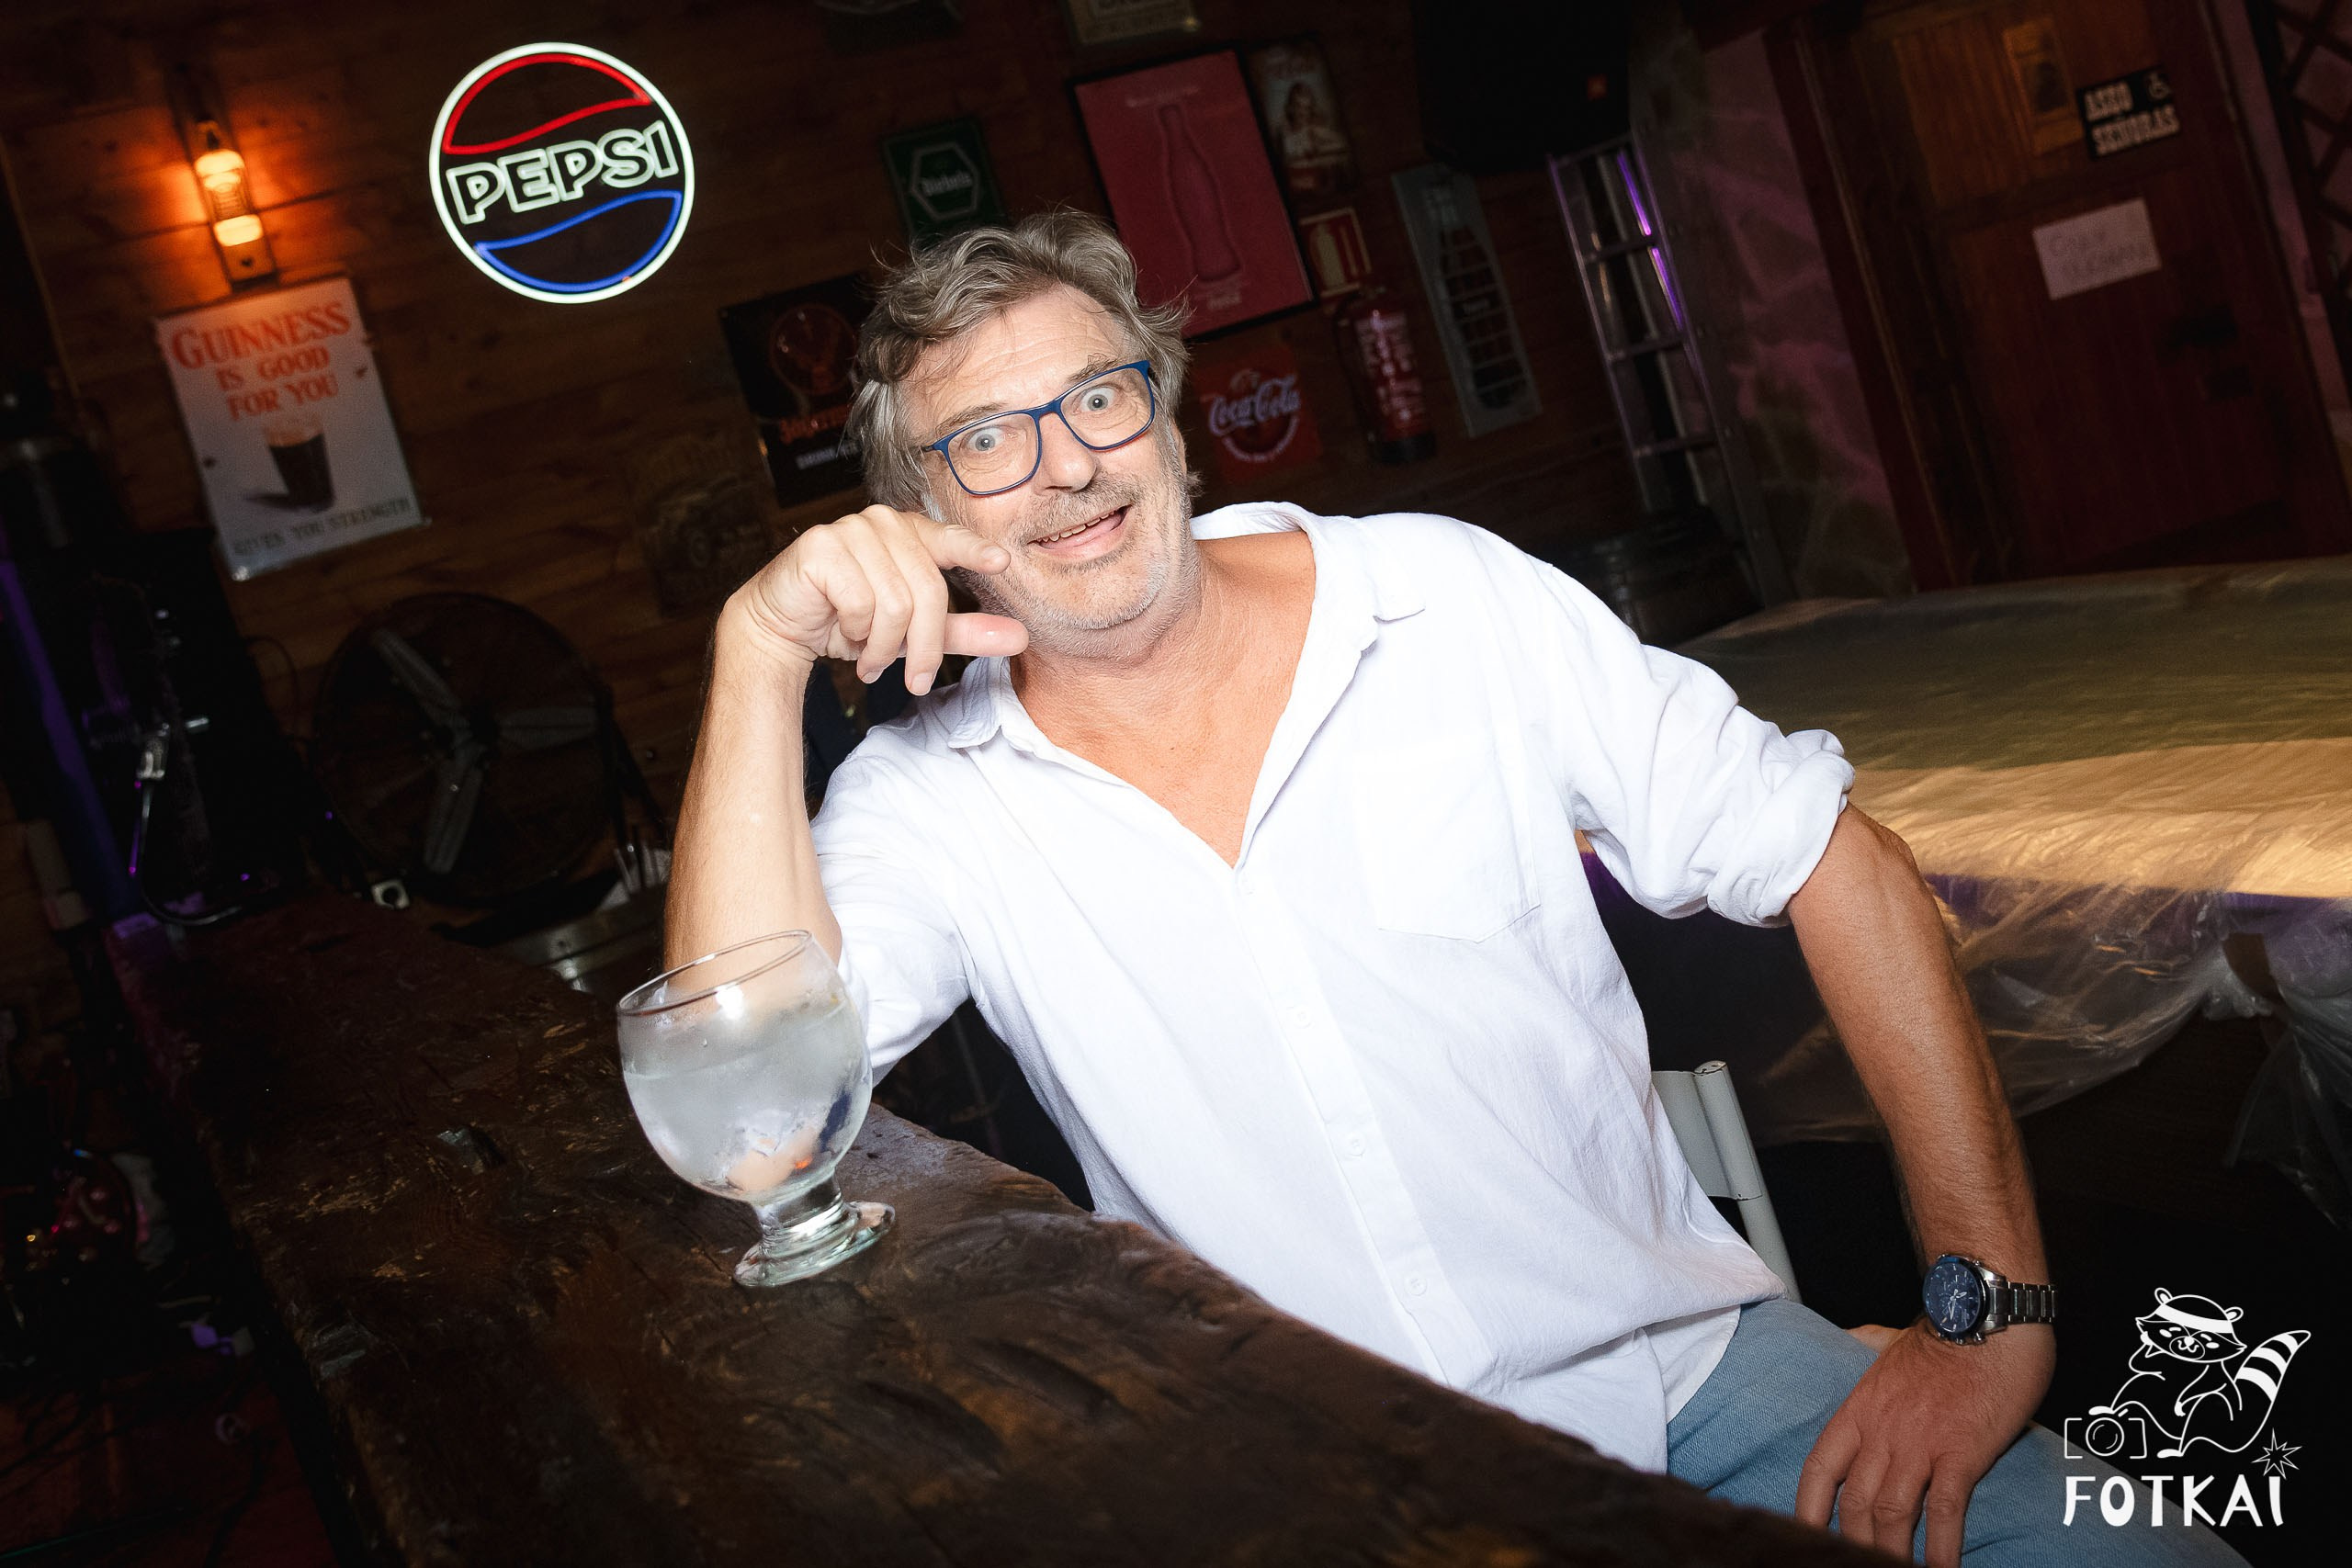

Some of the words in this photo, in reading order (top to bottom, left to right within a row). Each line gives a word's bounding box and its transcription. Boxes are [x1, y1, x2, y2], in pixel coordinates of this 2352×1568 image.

[446, 118, 680, 226] PEPSI
[173, 301, 350, 369] GUINNESS
[215, 367, 245, 392] IS
[257, 345, 332, 381] GOOD
[226, 389, 280, 422] FOR
[284, 372, 340, 406] YOU
